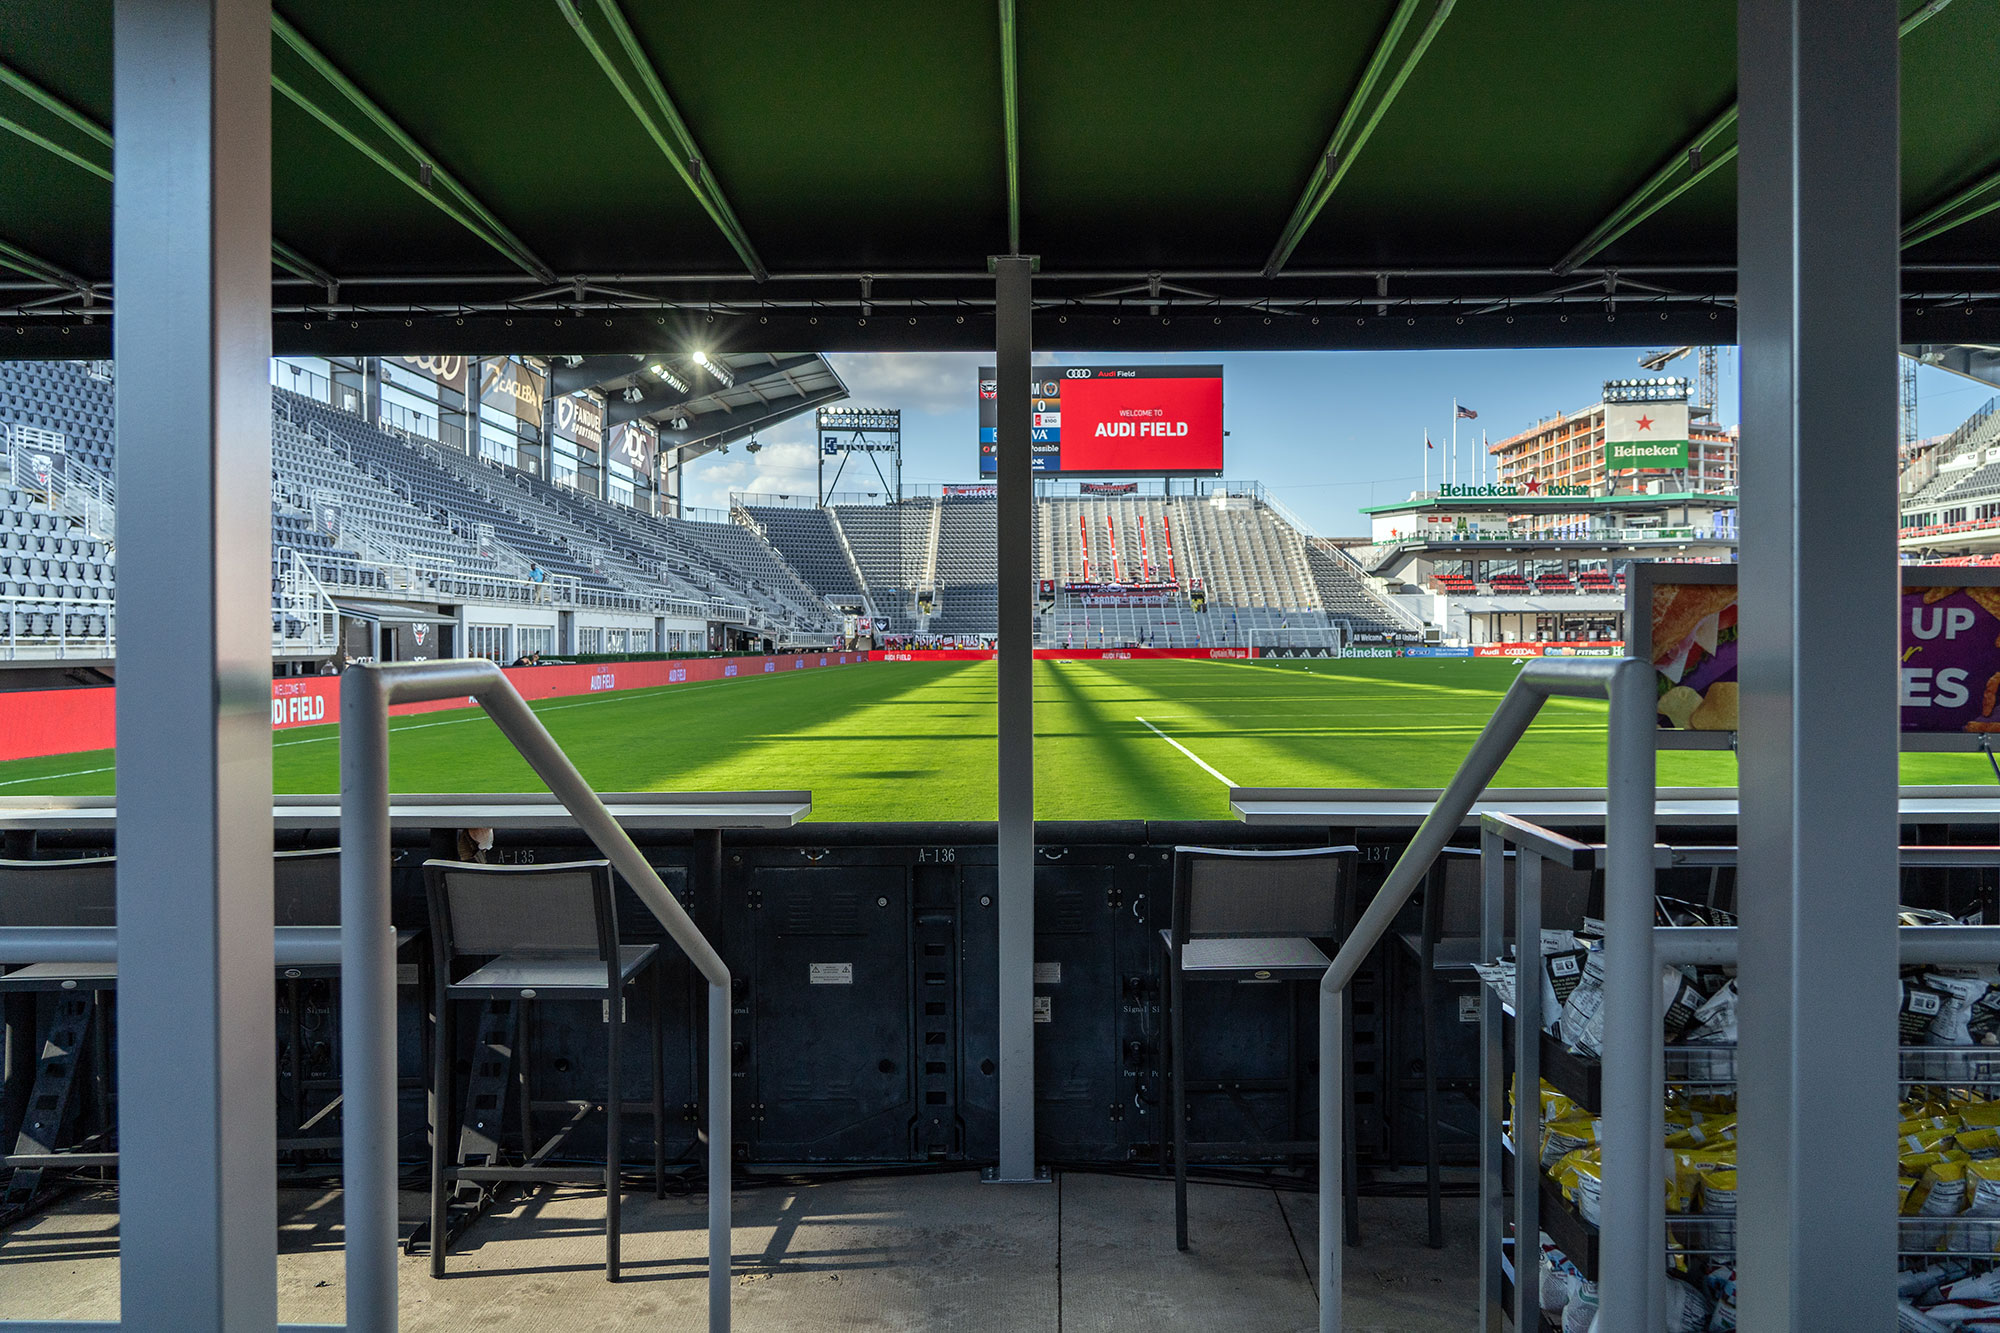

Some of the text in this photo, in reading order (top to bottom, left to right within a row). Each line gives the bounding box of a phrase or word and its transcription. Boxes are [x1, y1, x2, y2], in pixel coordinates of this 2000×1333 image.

[1098, 370, 1136, 378] Audi Field
[1037, 400, 1046, 412] 0
[1119, 409, 1163, 417] WELCOME TO
[1094, 421, 1188, 437] AUDI FIELD
[1439, 483, 1590, 497] Heineken ROOFTOP
[1911, 607, 1976, 640] UP
[884, 653, 912, 661] AUDI FIELD
[1101, 652, 1132, 660] AUDI FIELD
[1339, 647, 1392, 658] Heineken
[1900, 667, 1969, 708] ES
[289, 695, 325, 722] FIELD
[498, 849, 535, 864] A-135
[918, 848, 956, 863] A-136
[1358, 846, 1391, 861] -137
